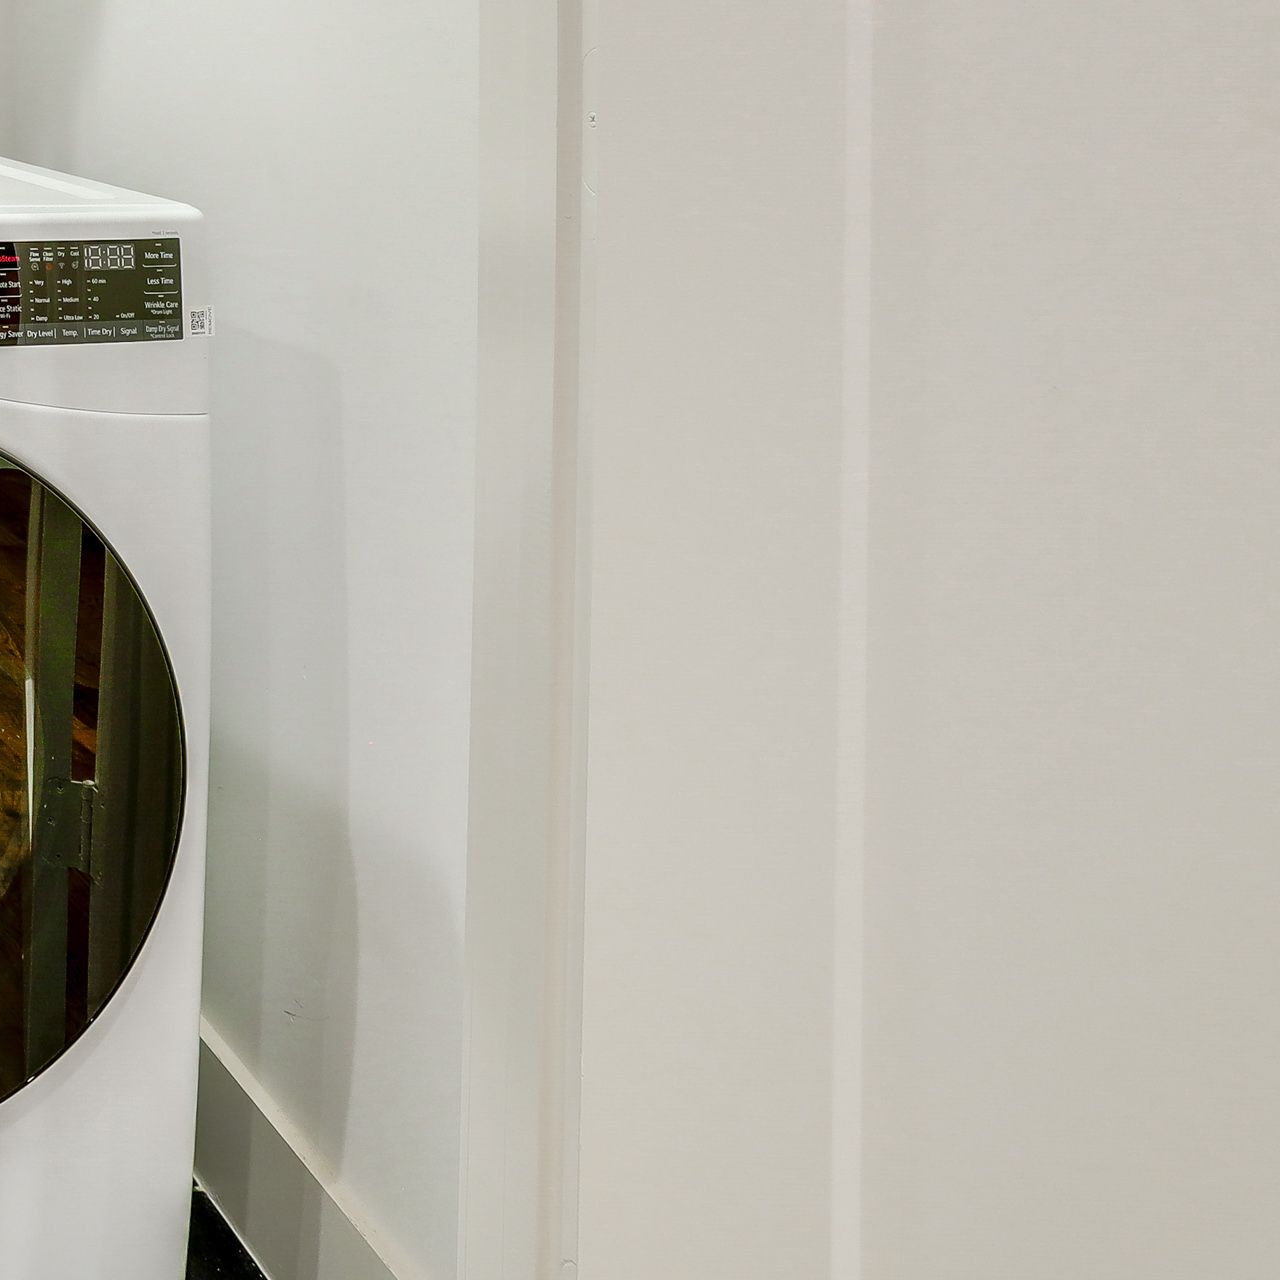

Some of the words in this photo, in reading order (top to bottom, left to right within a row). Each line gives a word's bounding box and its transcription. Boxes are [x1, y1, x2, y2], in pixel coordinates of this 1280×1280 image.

[147, 277, 160, 285] Less
[160, 277, 174, 285] Time
[144, 301, 165, 309] Wrinkle
[62, 329, 78, 337] Temp.
[88, 328, 101, 336] Time
[101, 328, 113, 336] Dry
[120, 327, 138, 336] Signal
[145, 325, 158, 333] Damp
[158, 325, 166, 333] Dry
[166, 325, 180, 333] Signal
[27, 331, 38, 339] Dry
